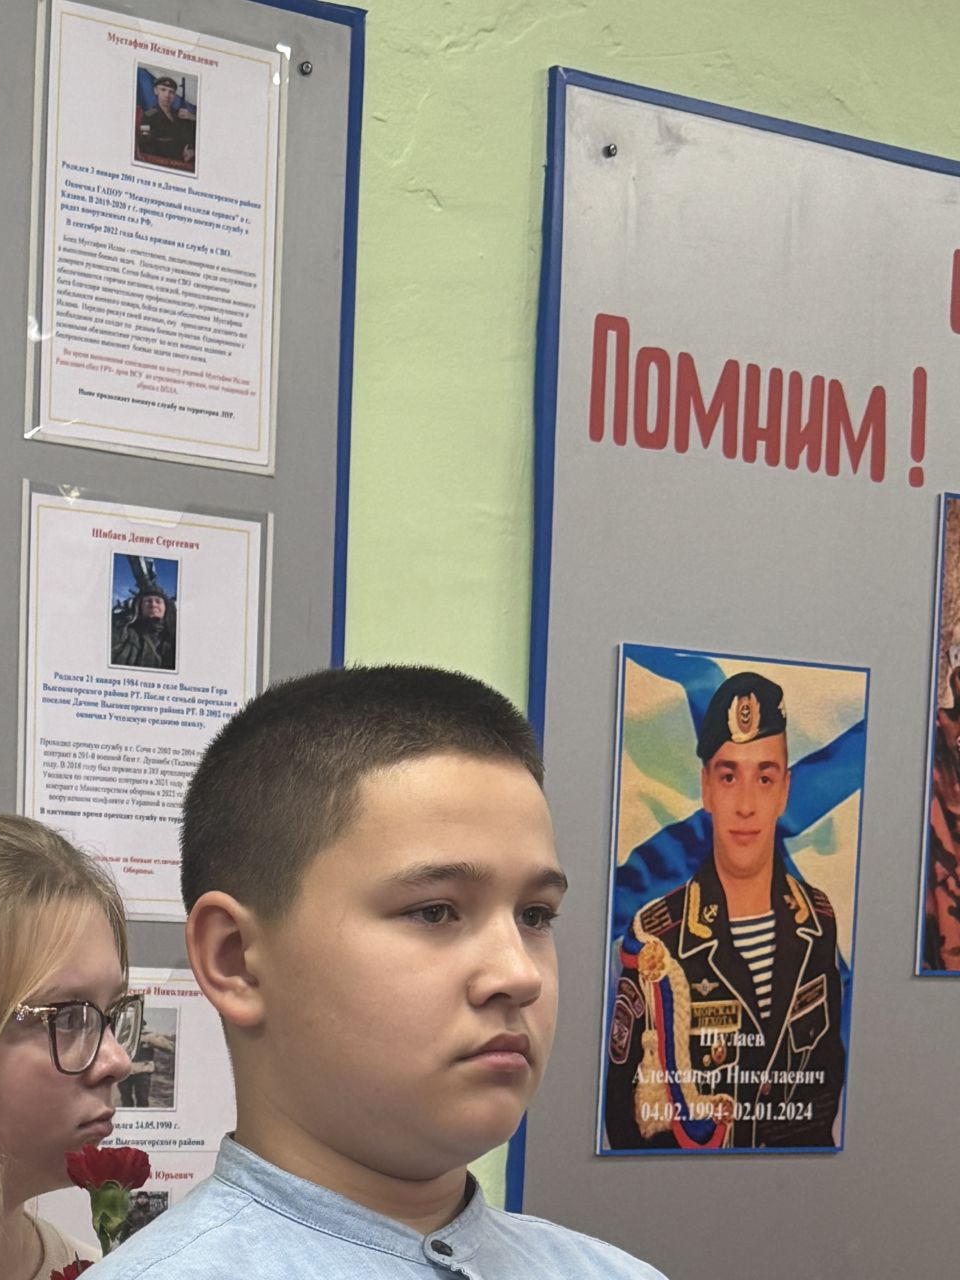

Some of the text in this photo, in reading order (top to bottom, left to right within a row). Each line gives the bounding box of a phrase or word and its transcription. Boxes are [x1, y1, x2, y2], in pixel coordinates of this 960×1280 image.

[700, 1028, 765, 1046] Шулаев
[632, 1069, 825, 1085] Александр Николаевич
[732, 1102, 813, 1121] 02.01.2024
